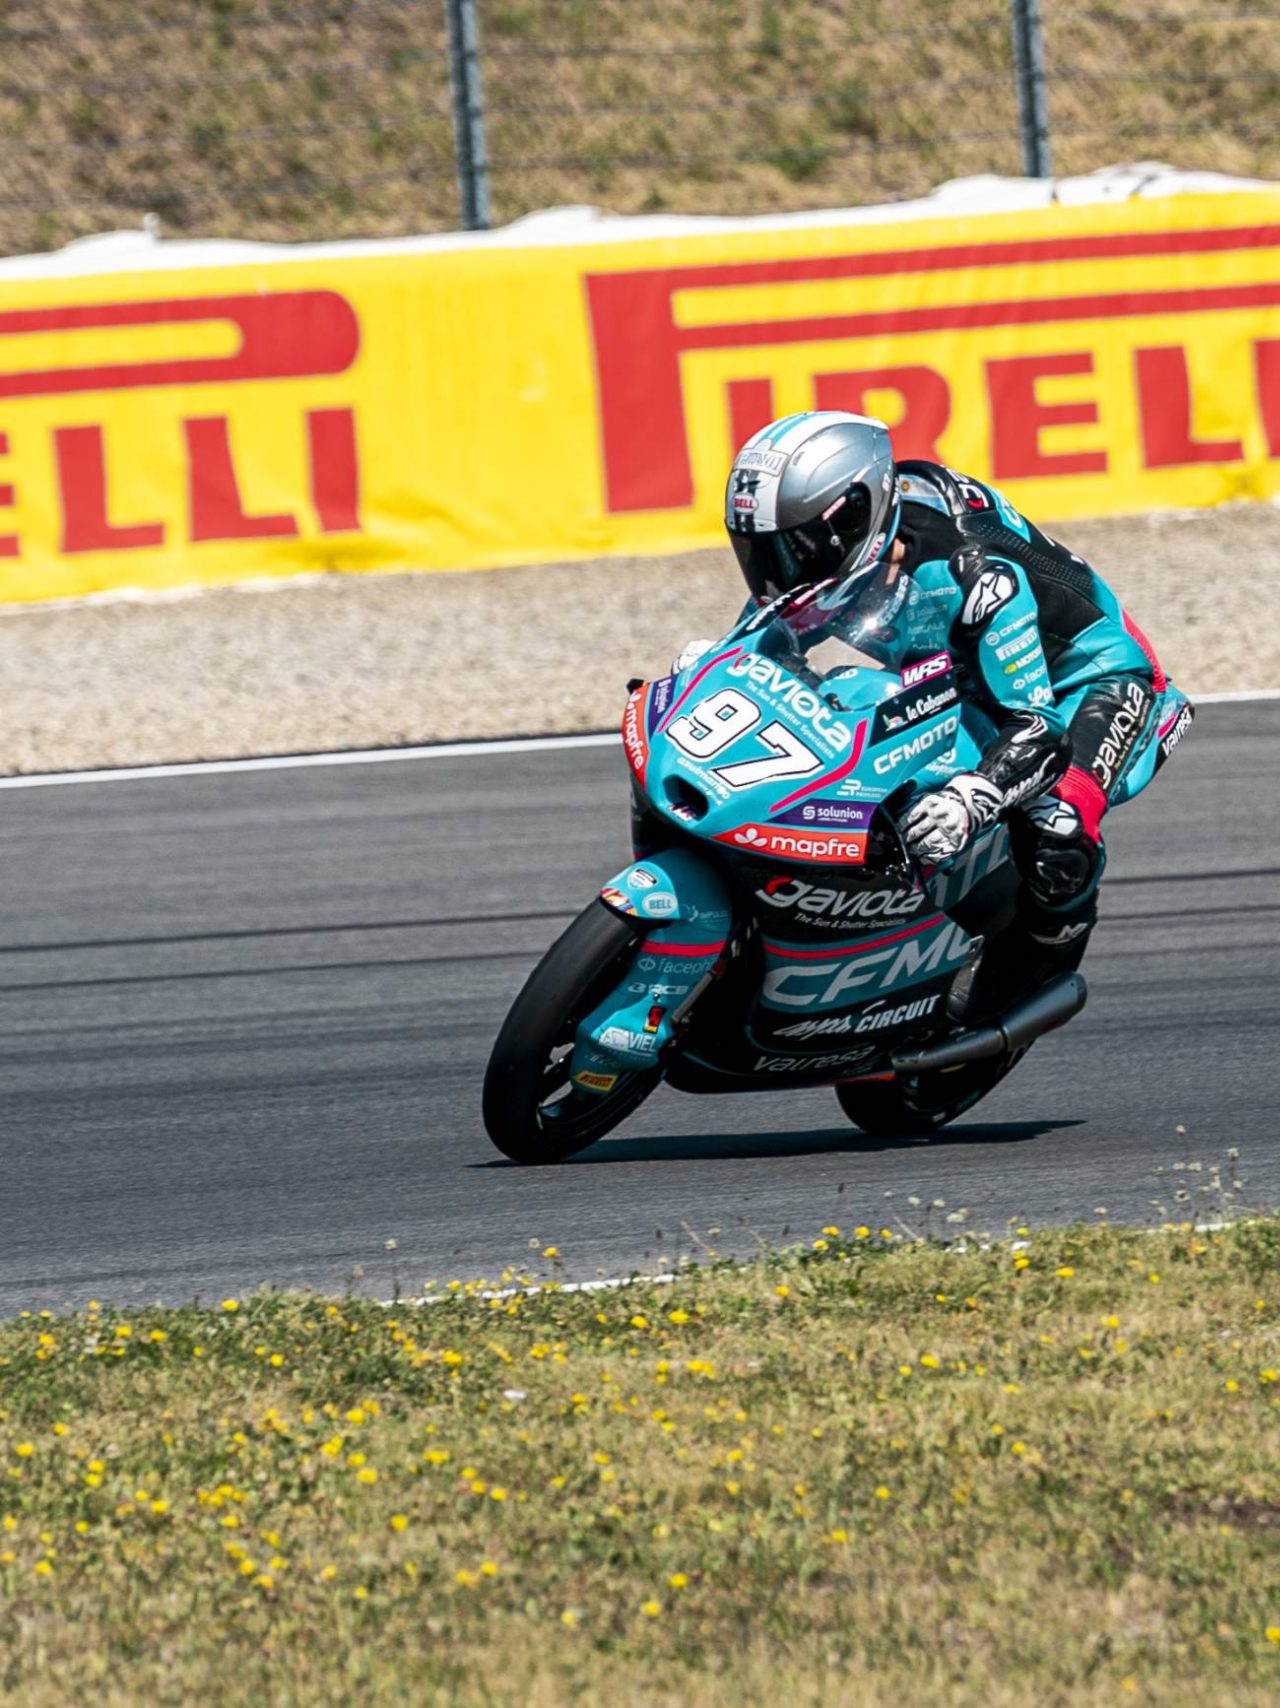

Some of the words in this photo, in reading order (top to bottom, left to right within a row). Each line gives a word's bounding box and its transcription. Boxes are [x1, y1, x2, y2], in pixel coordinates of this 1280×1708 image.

[734, 497, 754, 509] BELL
[903, 654, 948, 687] WRS
[725, 652, 852, 753] gaviota
[625, 708, 644, 770] mapfre
[664, 686, 825, 790] 97
[873, 715, 958, 775] CFMOTO
[817, 807, 864, 820] solunion
[770, 835, 861, 858] mapfre
[649, 897, 673, 910] BELL
[755, 875, 926, 918] gaviota
[657, 958, 716, 974] faceph
[854, 994, 941, 1034] CIRCUIT
